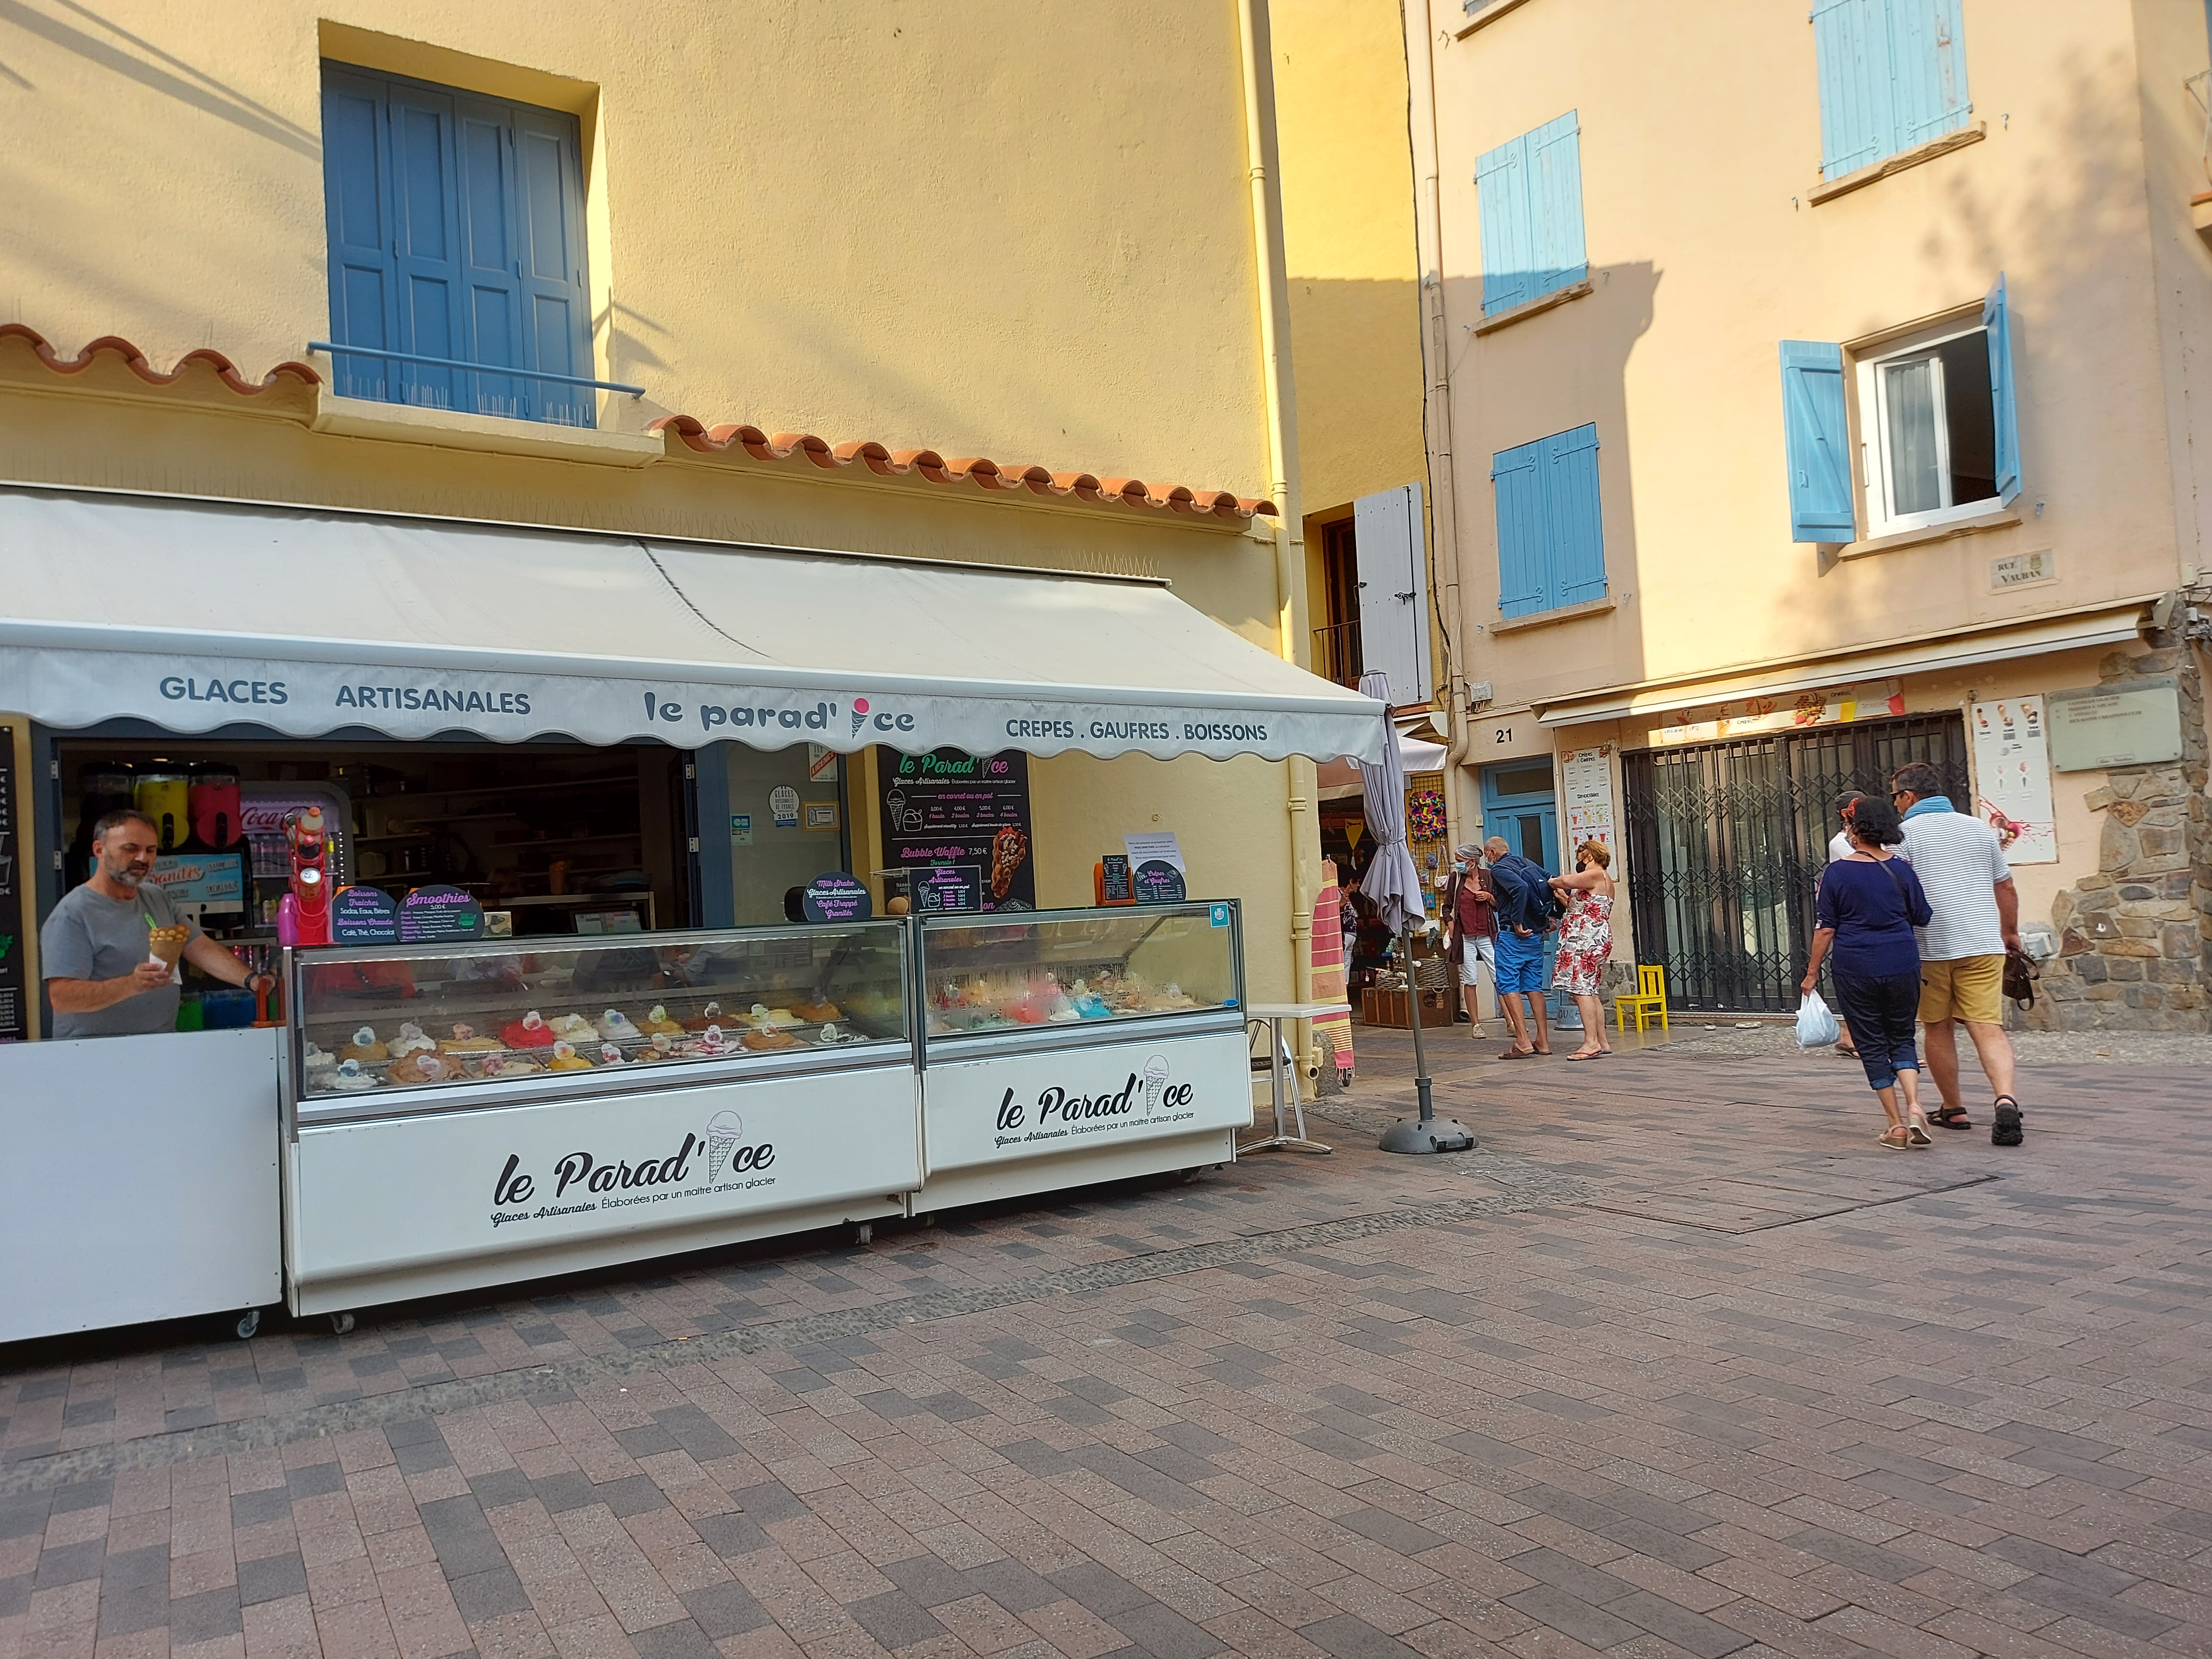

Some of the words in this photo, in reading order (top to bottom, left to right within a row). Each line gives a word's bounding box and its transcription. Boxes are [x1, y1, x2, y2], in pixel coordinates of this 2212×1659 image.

[1998, 561, 2016, 571] RUE
[2001, 571, 2041, 583] VAUBAN
[160, 677, 288, 705] GLACES
[335, 685, 531, 715] ARTISANALES
[644, 692, 683, 722] le
[1006, 719, 1074, 738] CREPES
[1090, 721, 1170, 740] GAUFRES
[1184, 723, 1268, 741] BOISSONS
[1496, 728, 1512, 744] 21
[811, 752, 836, 775] LICENCE
[899, 753, 915, 773] le
[892, 777, 914, 787] Glaces
[915, 777, 950, 785] Artisanales
[774, 789, 794, 798] GLACES
[982, 792, 994, 800] pot
[900, 847, 933, 858] Bubble
[933, 846, 966, 859] Waffle
[935, 868, 956, 877] Glaces
[816, 880, 833, 888] Milk
[833, 879, 855, 888] Shake
[928, 876, 963, 884] Artisanales
[1150, 877, 1171, 885] Gaufres
[347, 889, 378, 897] Boissons
[807, 888, 830, 898] Glaces
[829, 888, 866, 896] Artisanales
[406, 893, 471, 908] Smoothies
[816, 900, 833, 909] Café
[833, 899, 858, 908] Frappé
[825, 909, 853, 919] Granités
[337, 918, 367, 926] Boissons
[996, 1087, 1025, 1130] le
[994, 1135, 1022, 1149] Glaces
[1024, 1128, 1069, 1142] Artisanales
[1071, 1124, 1106, 1135] Élaborées
[1106, 1123, 1118, 1132] par
[1150, 1115, 1171, 1124] artisan
[1172, 1112, 1194, 1122] glacier
[494, 1153, 535, 1206] le
[490, 1212, 531, 1228] Glaces
[533, 1202, 597, 1219] Artisanales
[601, 1196, 650, 1209] Élaborées
[652, 1193, 669, 1204] par
[671, 1191, 682, 1199] un
[684, 1185, 712, 1196] maitre
[713, 1182, 743, 1193] artisan
[745, 1177, 776, 1189] glacier
